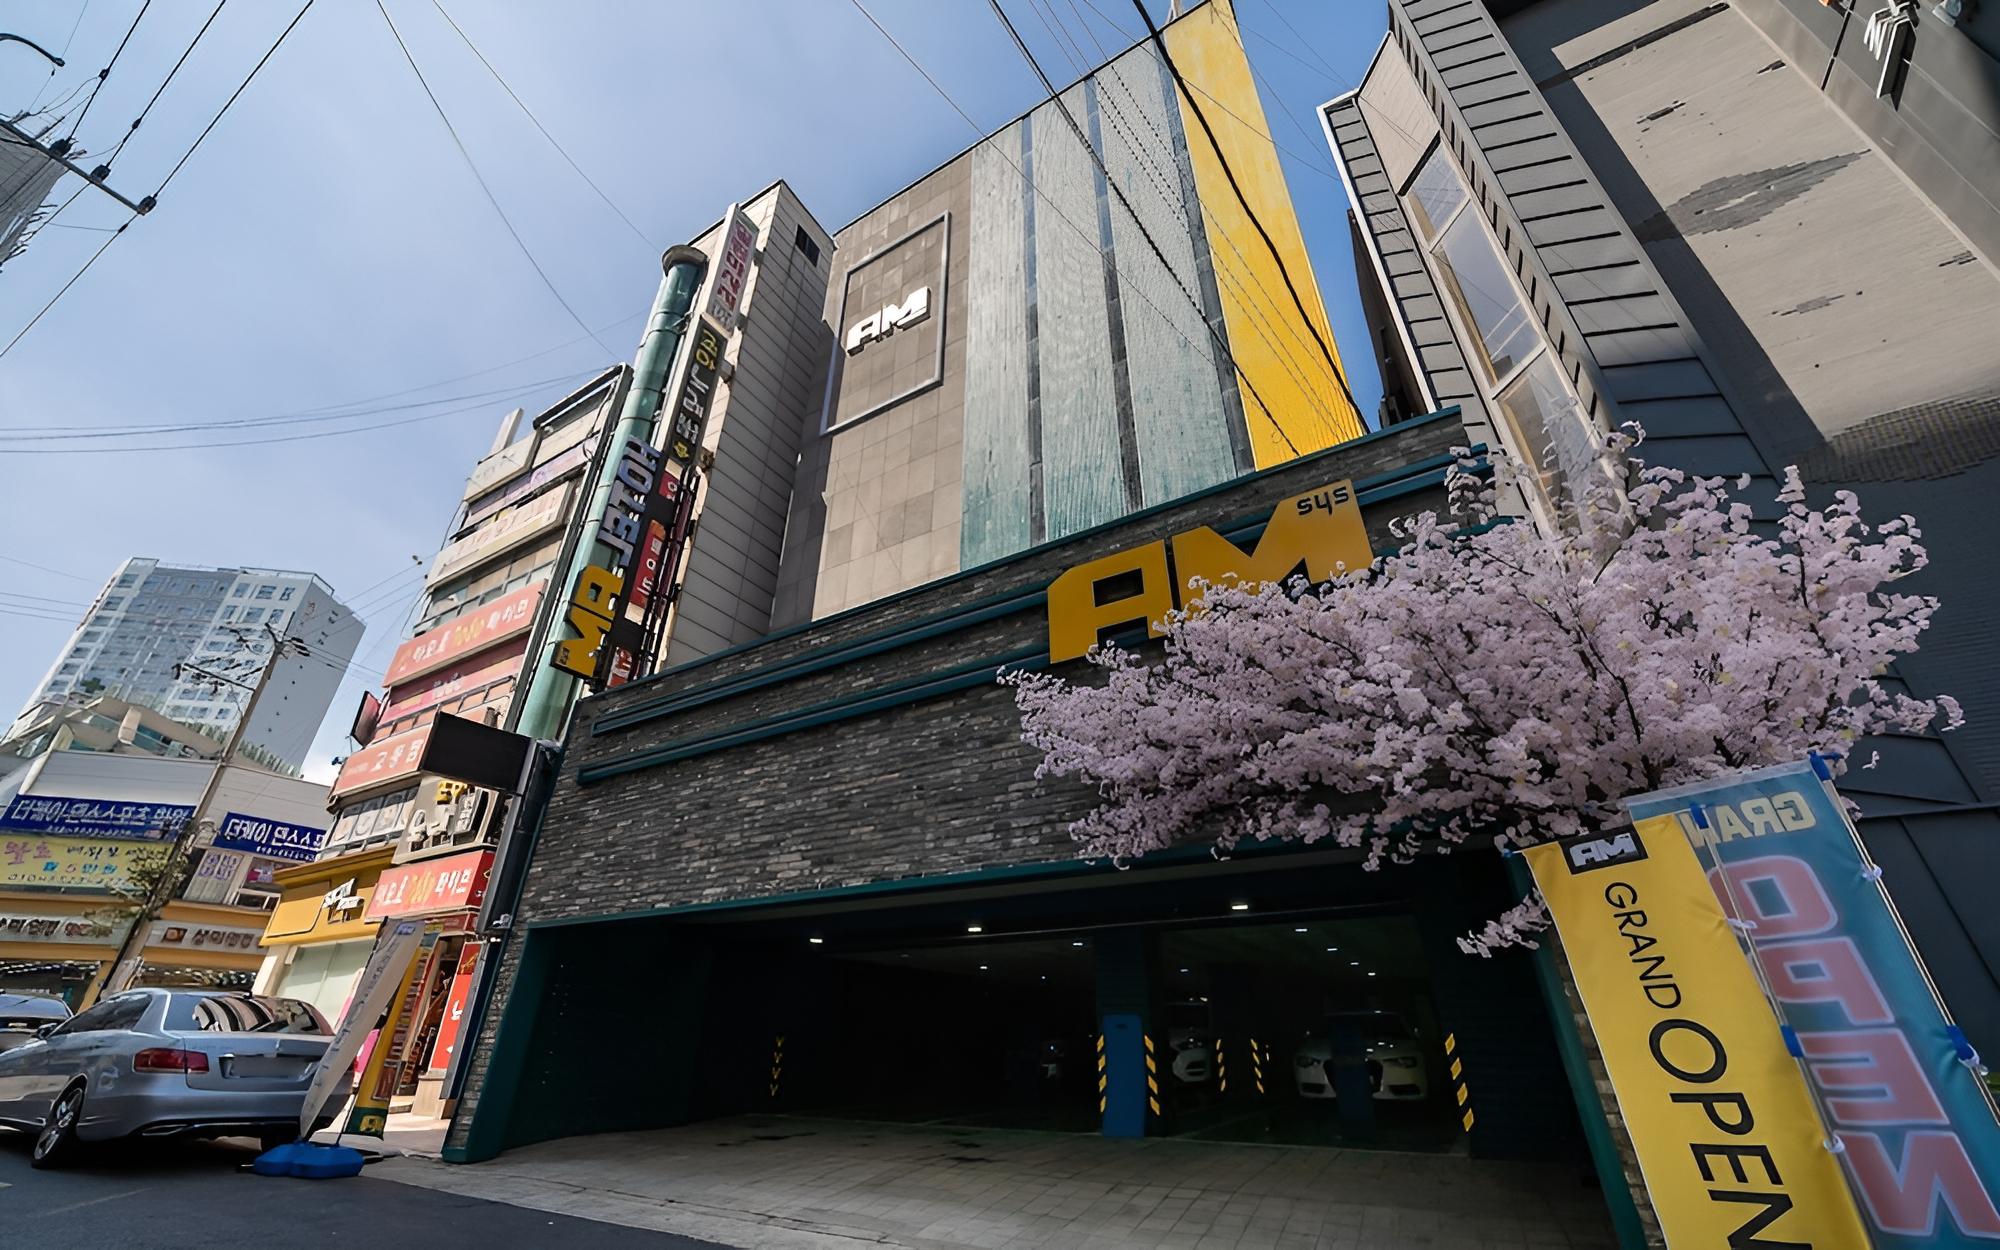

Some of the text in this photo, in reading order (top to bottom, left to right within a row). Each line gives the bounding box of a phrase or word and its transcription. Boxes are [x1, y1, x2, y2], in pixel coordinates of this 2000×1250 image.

[847, 286, 931, 355] AM
[1296, 486, 1349, 516] sys
[1047, 478, 1375, 665] AM
[1569, 832, 1638, 868] AM
[1604, 881, 1812, 1250] GRAND OPEN
